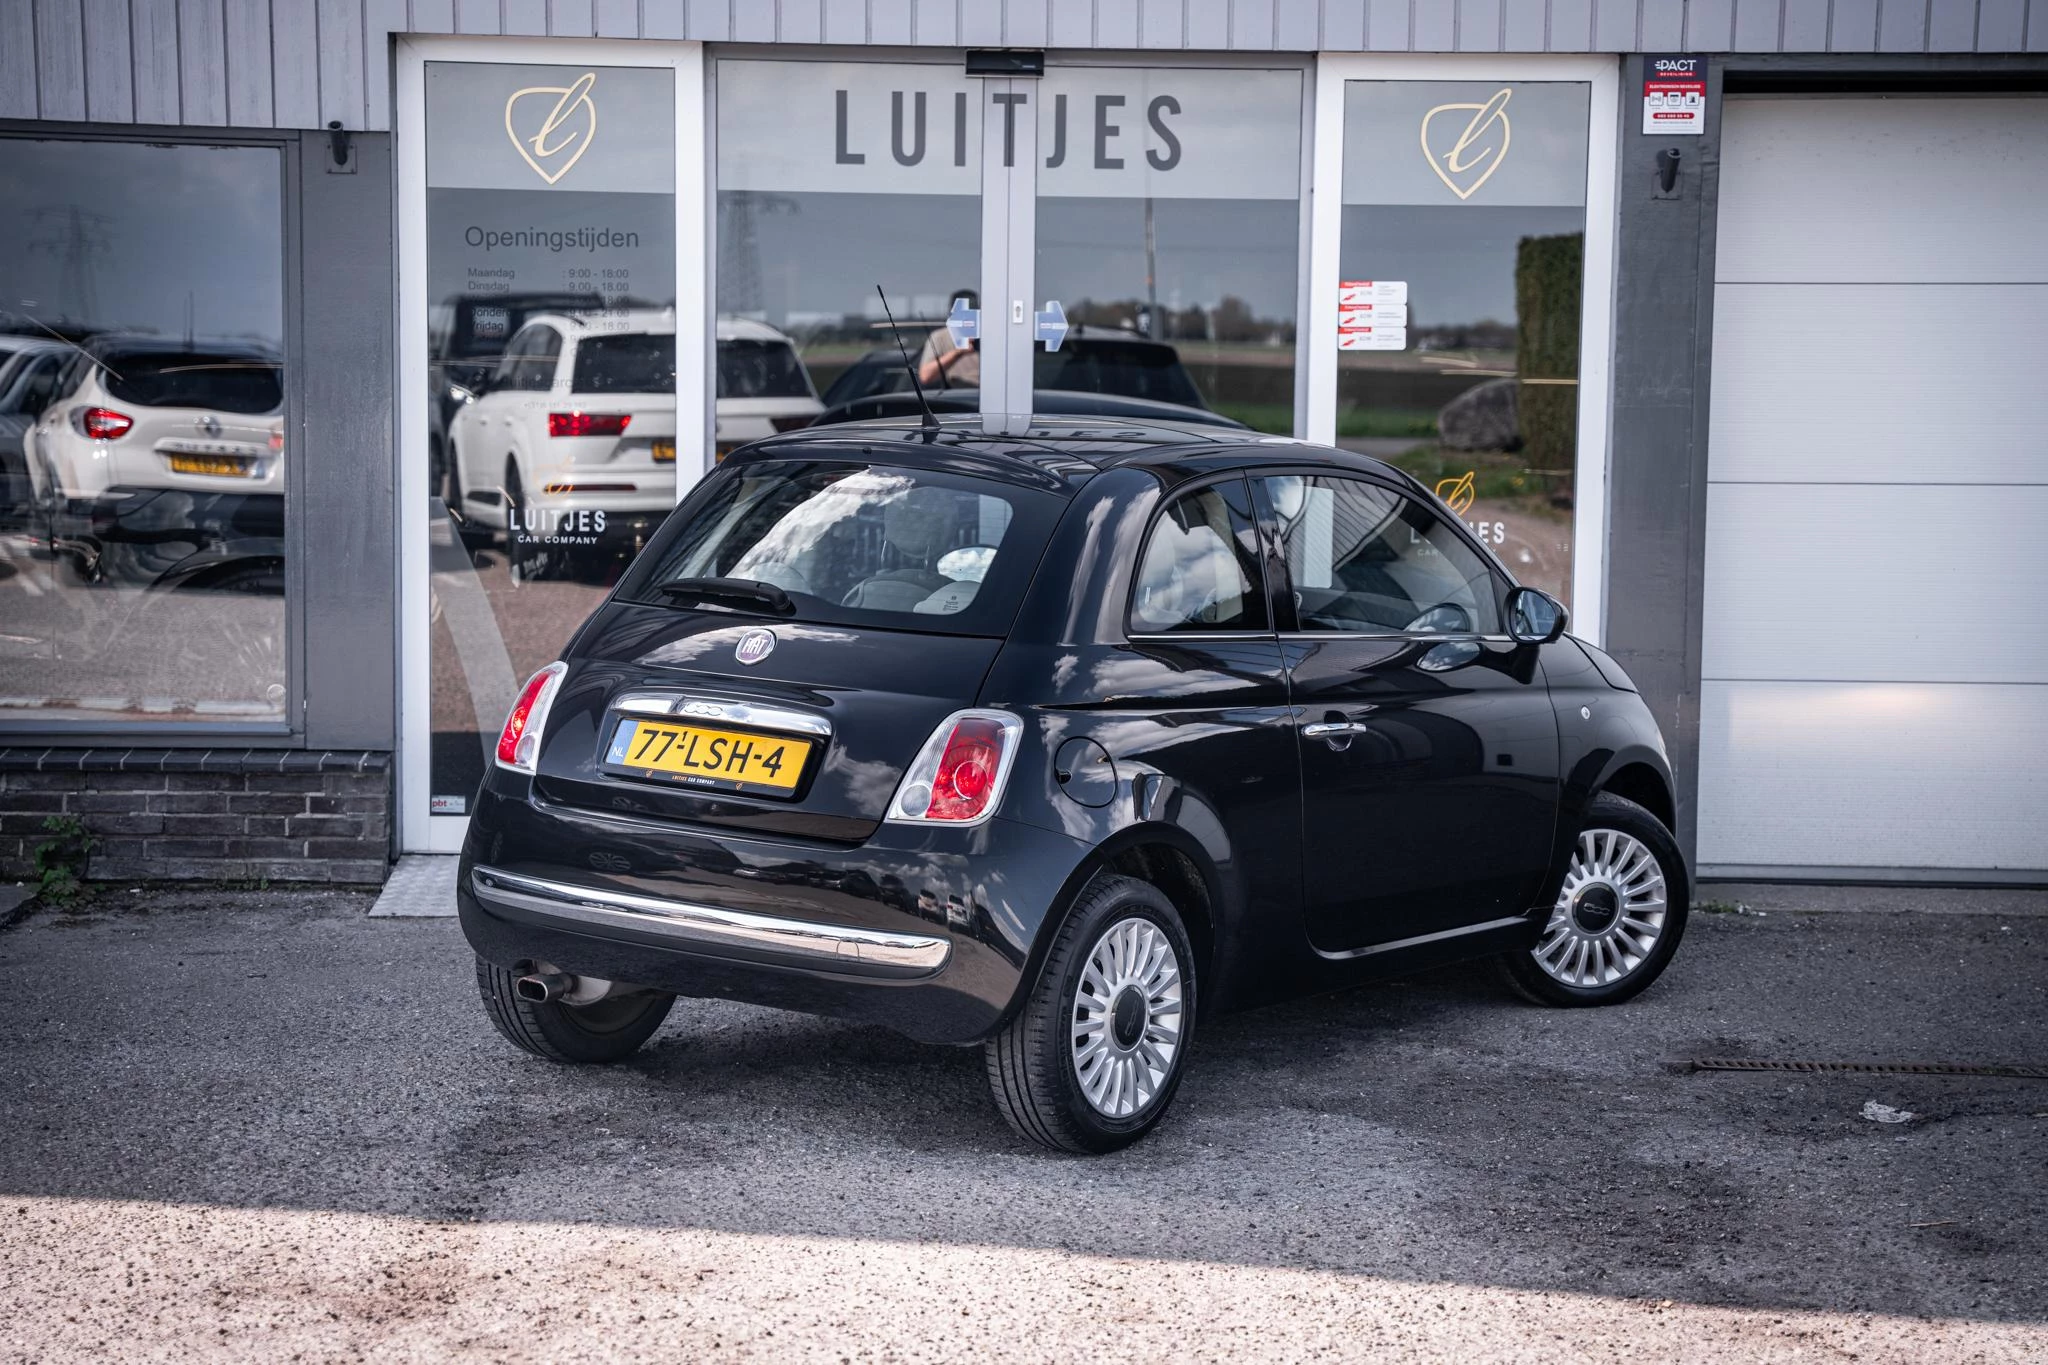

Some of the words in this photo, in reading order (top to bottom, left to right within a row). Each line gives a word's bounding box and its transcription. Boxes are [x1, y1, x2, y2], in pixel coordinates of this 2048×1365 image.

[1659, 59, 1697, 71] PACT
[835, 89, 1182, 172] LUITJES
[464, 225, 639, 253] Openingstijden
[467, 268, 515, 280] Maandag
[467, 281, 510, 292] Dinsdag
[509, 508, 607, 533] LUITJES
[517, 535, 540, 544] CAR
[544, 535, 598, 545] COMPANY
[611, 746, 624, 758] NL
[634, 728, 786, 778] 77-LSH-4
